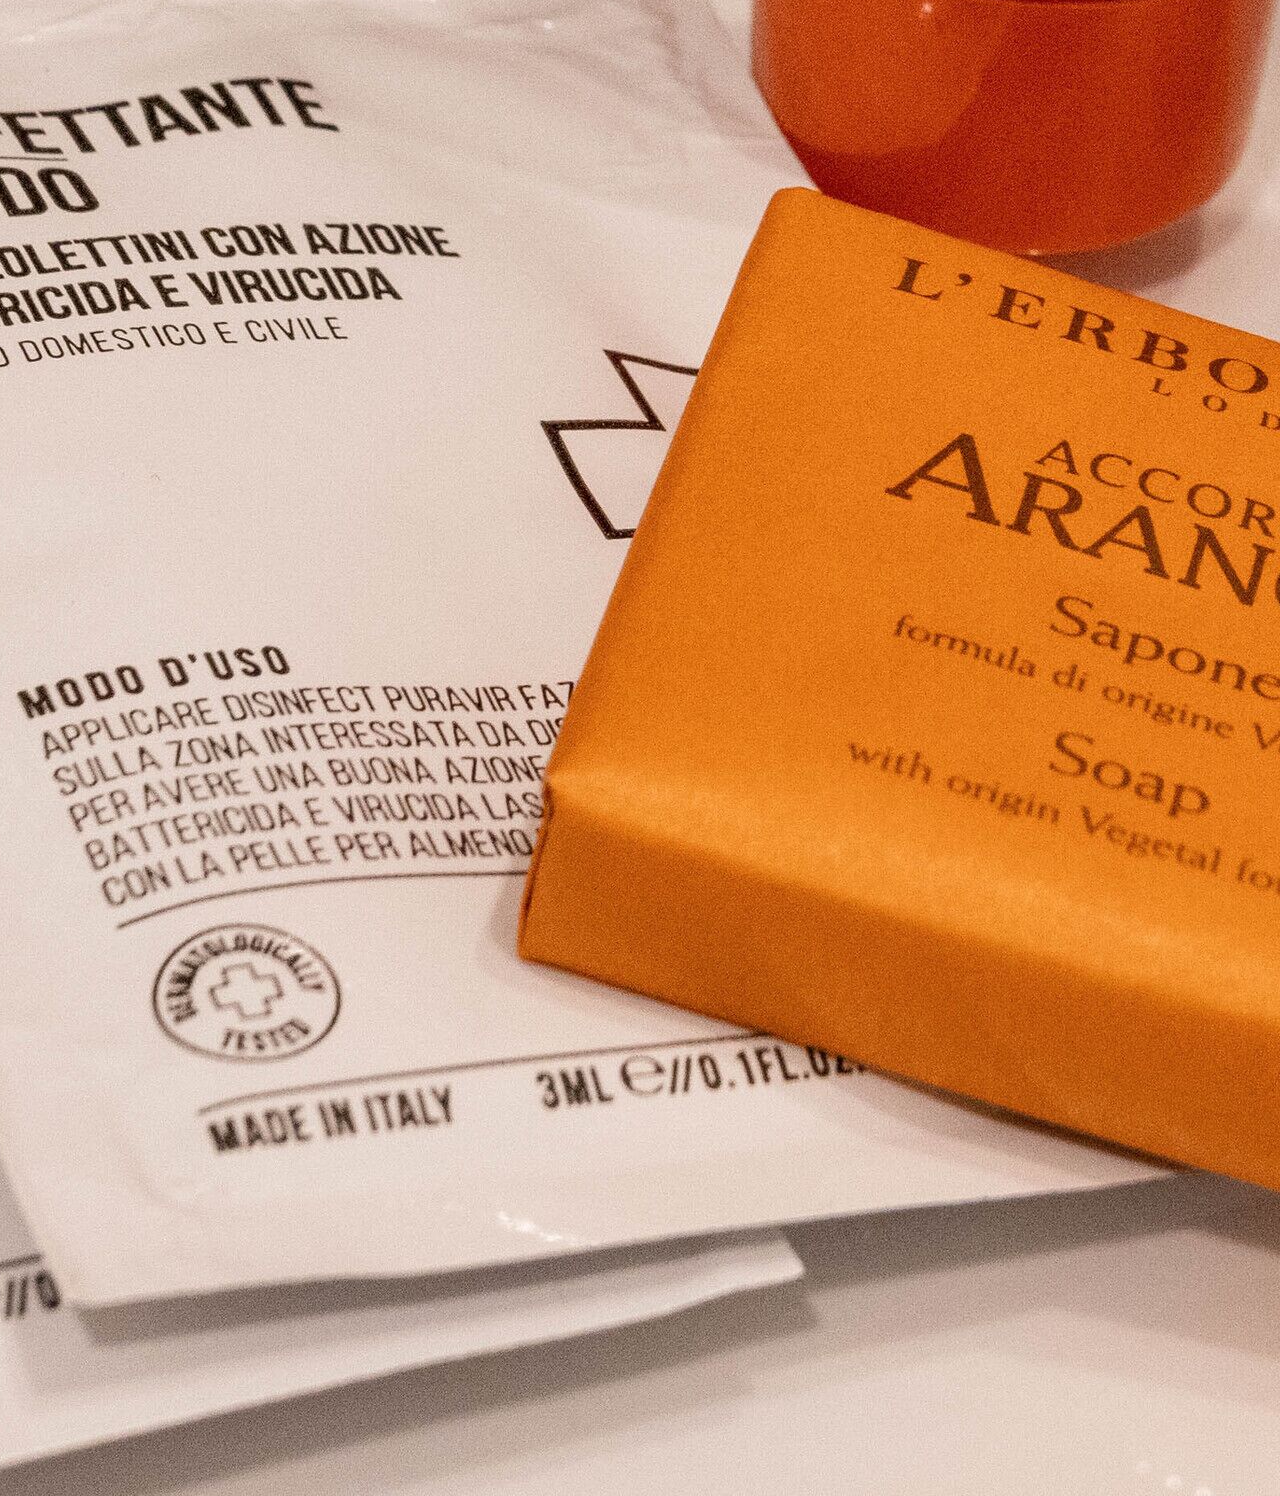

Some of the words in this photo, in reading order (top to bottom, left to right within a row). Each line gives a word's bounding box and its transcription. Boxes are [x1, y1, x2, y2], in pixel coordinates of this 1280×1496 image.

[201, 223, 293, 260] CON
[306, 221, 461, 259] AZIONE
[159, 274, 190, 310] E
[187, 266, 403, 307] VIRUCIDA
[19, 321, 206, 365] DOMESTICO
[214, 321, 238, 344] E
[244, 315, 348, 344] CIVILE
[17, 664, 145, 719] MODO
[160, 644, 291, 688] D'USO
[893, 614, 1037, 680] formula
[1051, 661, 1087, 694] di
[1101, 680, 1235, 742] origine
[42, 698, 219, 760] APPLICARE
[229, 685, 375, 722] DISINFECT
[382, 686, 517, 712] PURAVIR
[52, 747, 161, 796] SULLA
[172, 732, 259, 769] ZONA
[262, 720, 475, 755] INTERESSATA
[476, 721, 525, 747] DA
[68, 790, 136, 833] PER
[144, 771, 255, 811] AVERE
[257, 760, 321, 793] UNA
[328, 754, 437, 788] BUONA
[847, 740, 933, 784] with
[945, 769, 1061, 826] origin
[1079, 805, 1221, 874] Vegetal
[1048, 730, 1212, 818] Soap
[85, 801, 301, 871] BATTERICIDA
[303, 795, 324, 827] E
[331, 791, 480, 824] VIRUCIDA
[101, 861, 172, 906] CON
[178, 850, 226, 886] LA
[228, 834, 331, 874] PELLE
[335, 829, 400, 861] PER
[409, 828, 533, 859] ALMENO
[208, 1103, 312, 1155] MADE
[318, 1099, 358, 1141] IN
[363, 1085, 454, 1130] ITALY
[536, 1066, 615, 1109] 3ML
